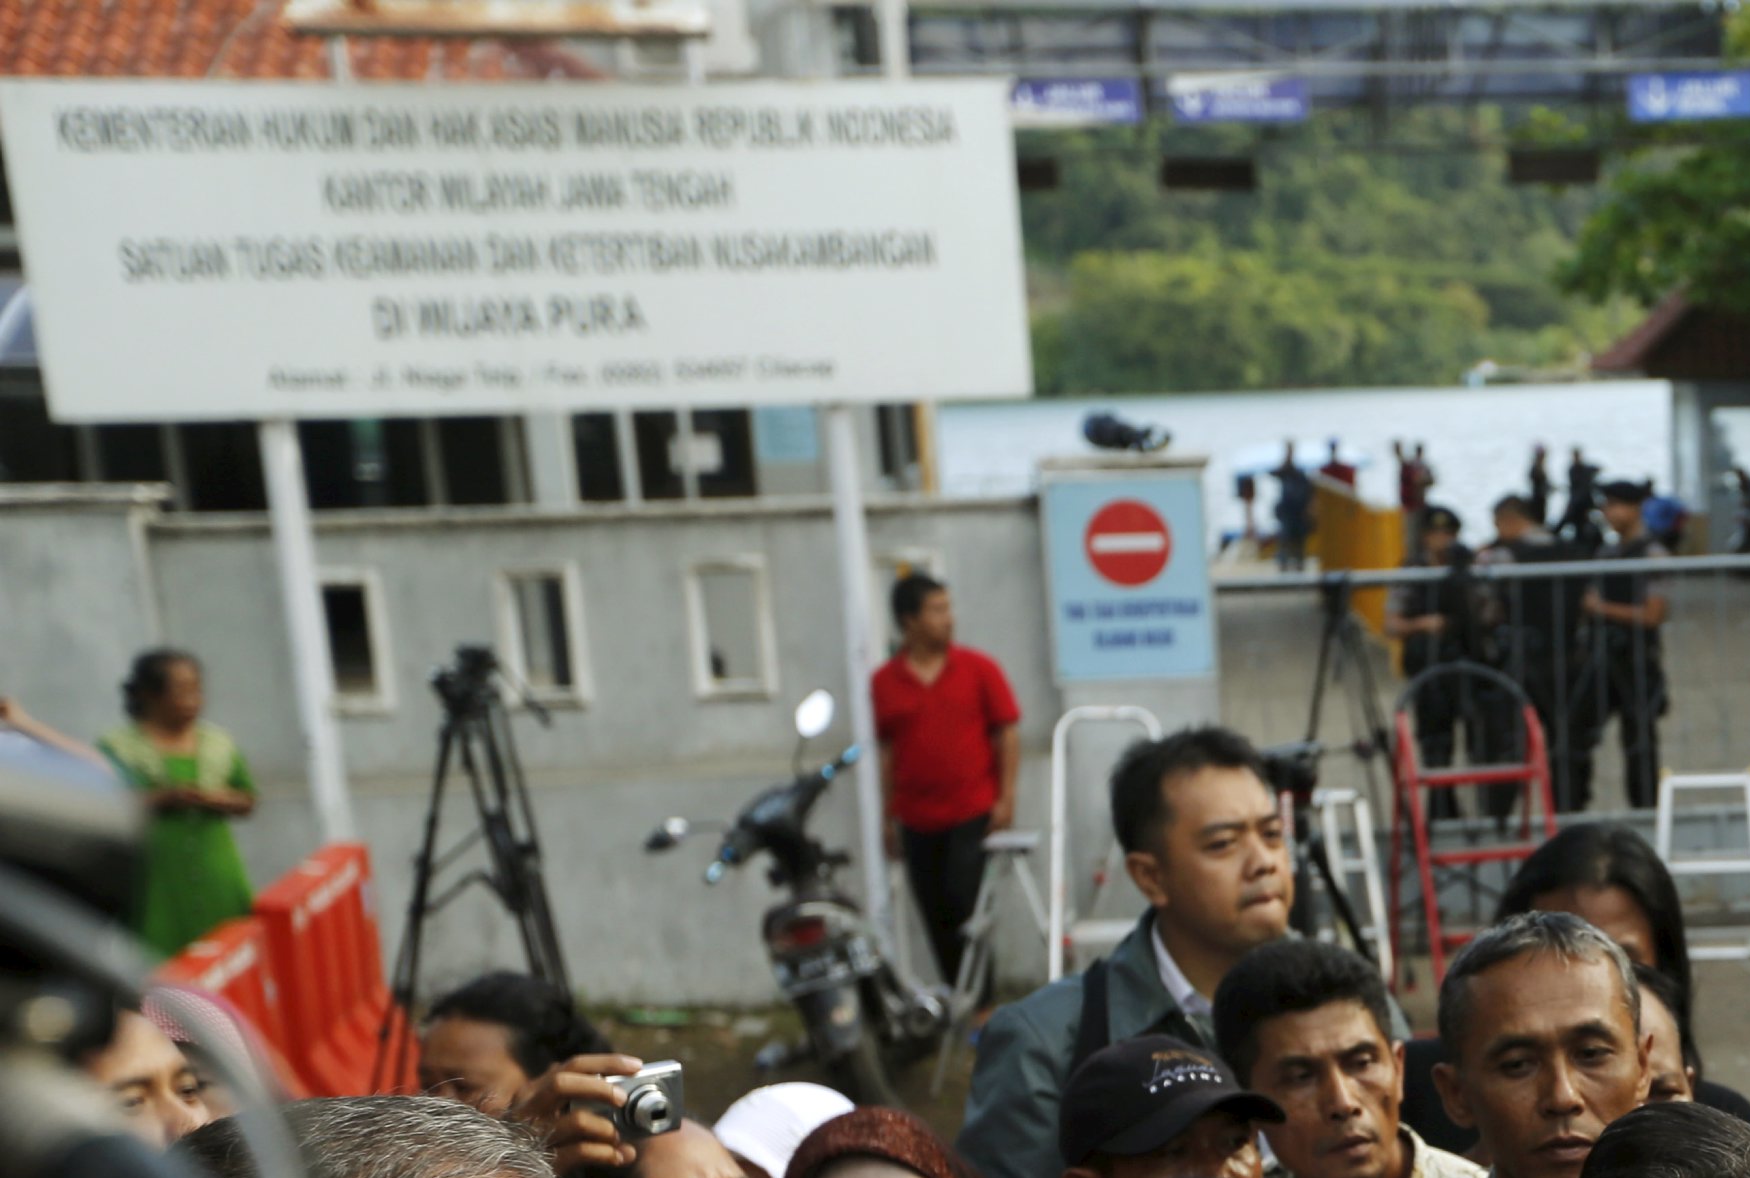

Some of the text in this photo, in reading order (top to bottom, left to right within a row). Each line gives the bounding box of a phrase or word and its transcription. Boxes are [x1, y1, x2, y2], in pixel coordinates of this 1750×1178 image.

[57, 104, 253, 151] KEMENTERIAN
[259, 105, 356, 151] HUKUM
[364, 106, 420, 148] DAN
[574, 105, 685, 149] MANUSIA
[694, 105, 815, 150] REPUBLIK
[827, 105, 959, 147] INDONESIA
[324, 169, 735, 213] KANTOR WILAYAH JAWA TENGAH
[120, 228, 938, 284] SATUAN TUGAS KEAMANAN DAN KETERTIBAN NUSAKAMBANGAN
[373, 293, 650, 340] DI WIJAYA PURA
